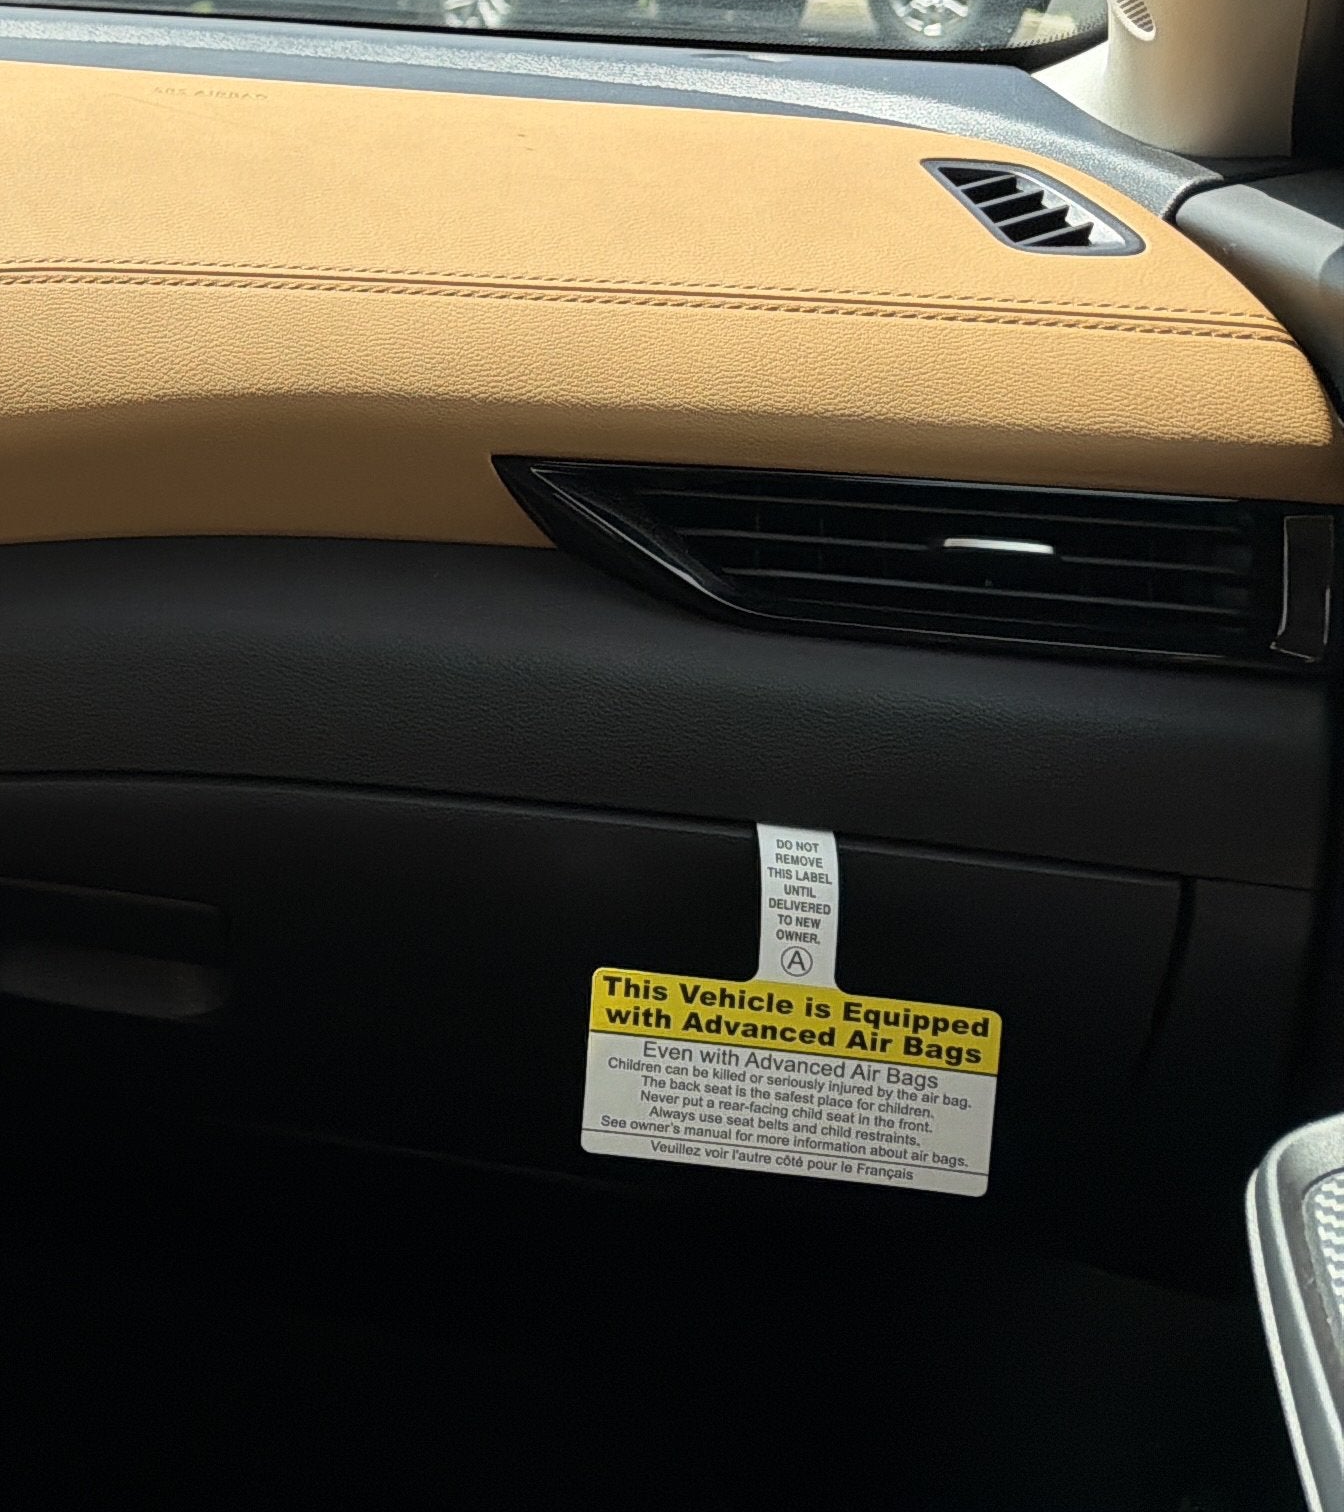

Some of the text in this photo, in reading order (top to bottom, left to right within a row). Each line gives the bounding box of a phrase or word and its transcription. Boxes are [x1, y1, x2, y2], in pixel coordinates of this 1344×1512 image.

[776, 839, 819, 853] DO NOT
[776, 853, 823, 868] REMOVE
[767, 867, 832, 885] THIS LABEL
[784, 884, 816, 898] UNTIL
[768, 898, 831, 915] DELIVERED
[777, 914, 821, 929] TO NEW
[776, 929, 820, 945] OWNER.
[787, 950, 806, 971] A
[603, 976, 989, 1037] This Vehicle is Equipped
[606, 1006, 980, 1066] with Advanced Air Bags
[608, 1056, 970, 1110] Children can be killed or seriously injured by the air bag.
[643, 1040, 938, 1093] Even with Advanced Air Bags
[640, 1090, 932, 1132] Never put a rear-facing child seat in the front.
[641, 1075, 934, 1118] The back seat is the safest place for children.
[601, 1114, 967, 1168] See owner's manual for more information about air bags.
[649, 1105, 920, 1146] Always use seat belts and child restraints.
[650, 1140, 913, 1180] Veuillez voir l'autre côté pour le Français
